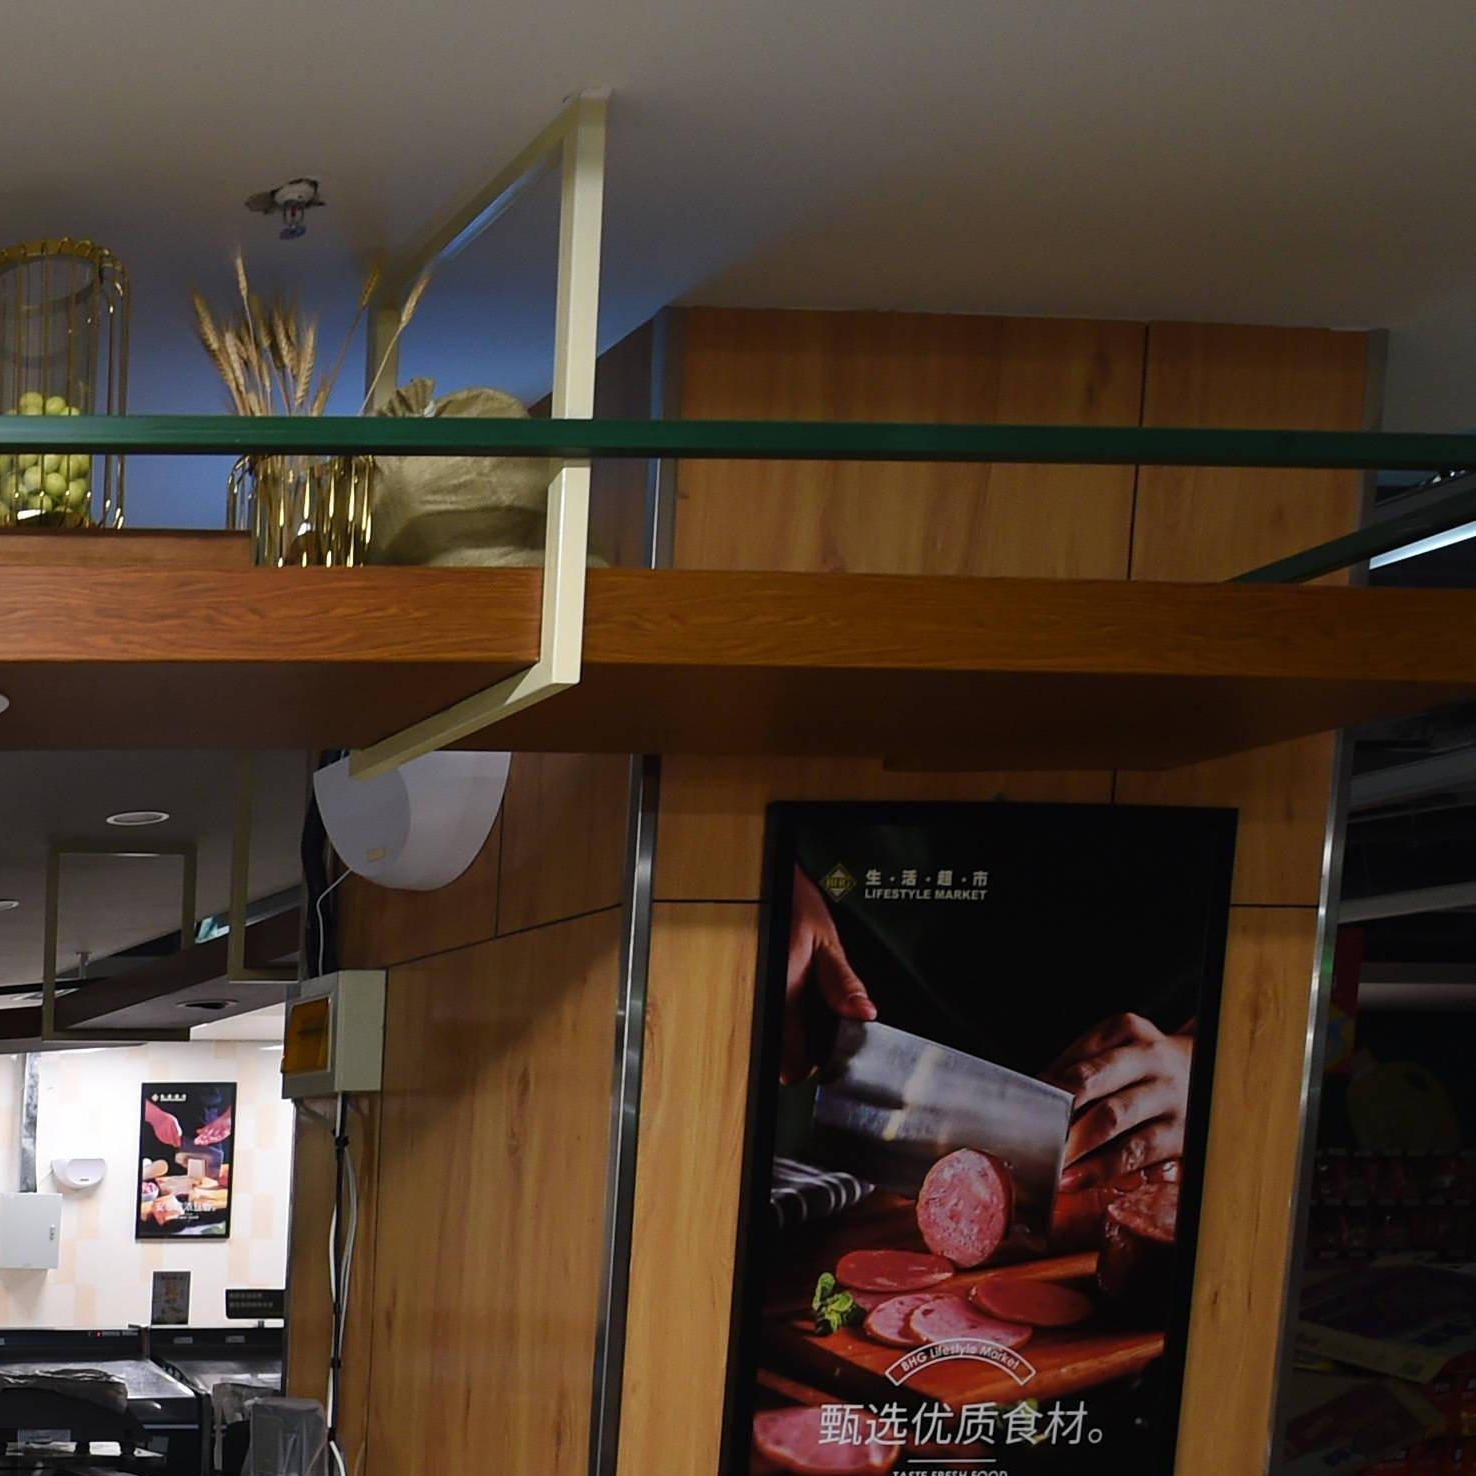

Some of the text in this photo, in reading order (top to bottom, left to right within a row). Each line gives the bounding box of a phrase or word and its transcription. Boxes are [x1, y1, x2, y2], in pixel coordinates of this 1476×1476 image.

[864, 888, 988, 900] LIFESTYLE MARKET
[900, 1341, 1020, 1372] BHG Lifestyle Market
[818, 1401, 1103, 1446] 甄选优质食材。
